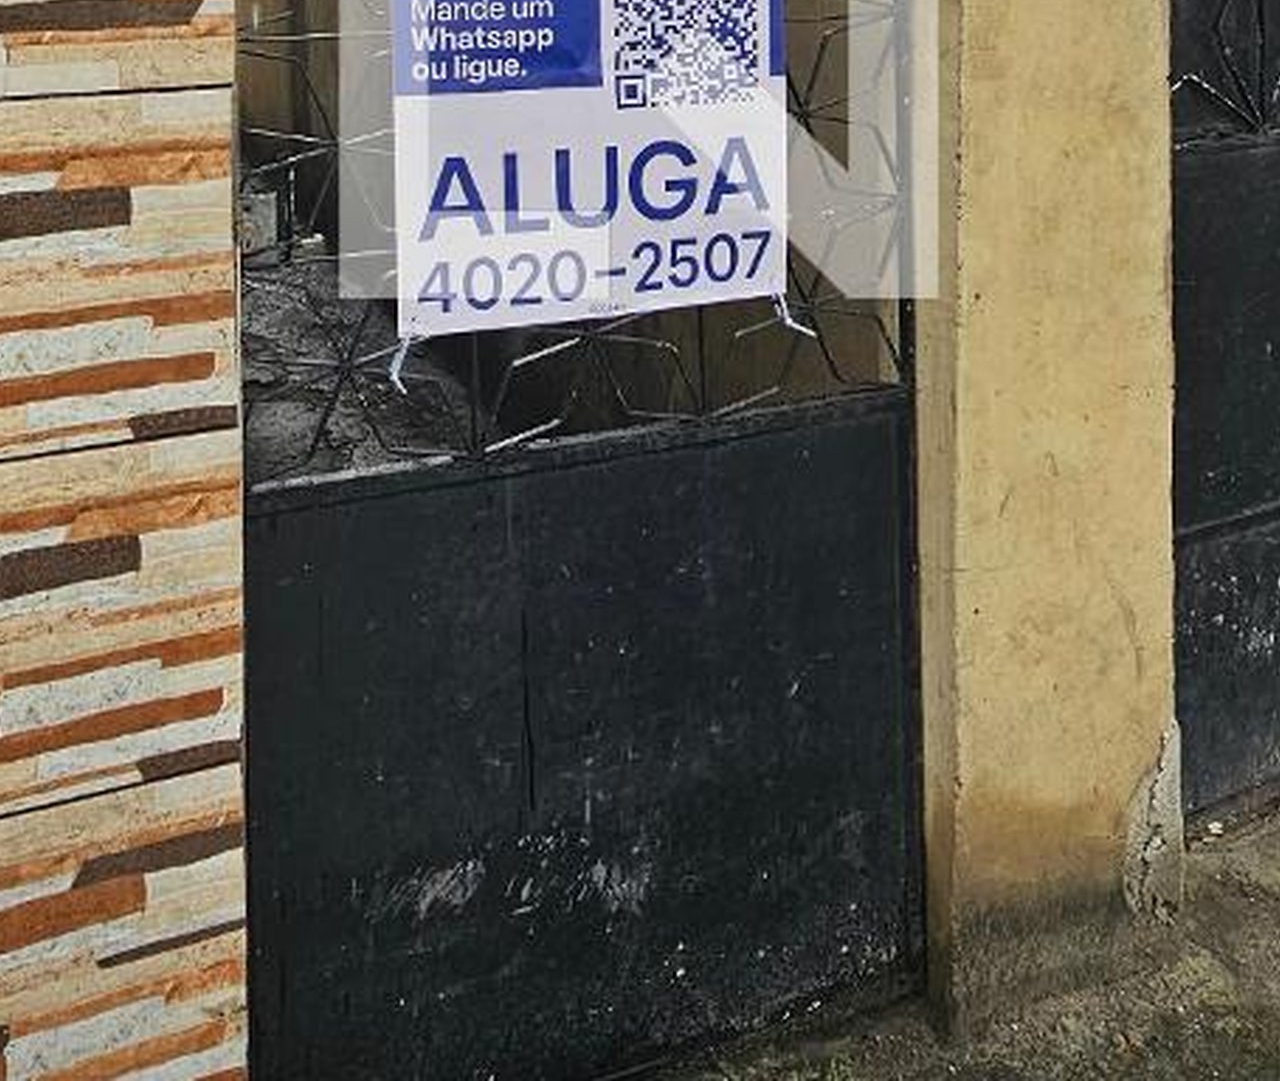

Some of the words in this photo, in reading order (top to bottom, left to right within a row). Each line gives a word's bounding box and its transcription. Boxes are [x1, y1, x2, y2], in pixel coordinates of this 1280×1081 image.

[512, 0, 554, 19] um
[410, 26, 555, 53] Whatsapp
[411, 61, 448, 81] ou
[454, 54, 528, 85] ligue.
[418, 136, 770, 243] ALUGA
[417, 230, 772, 314] 4020-2507
